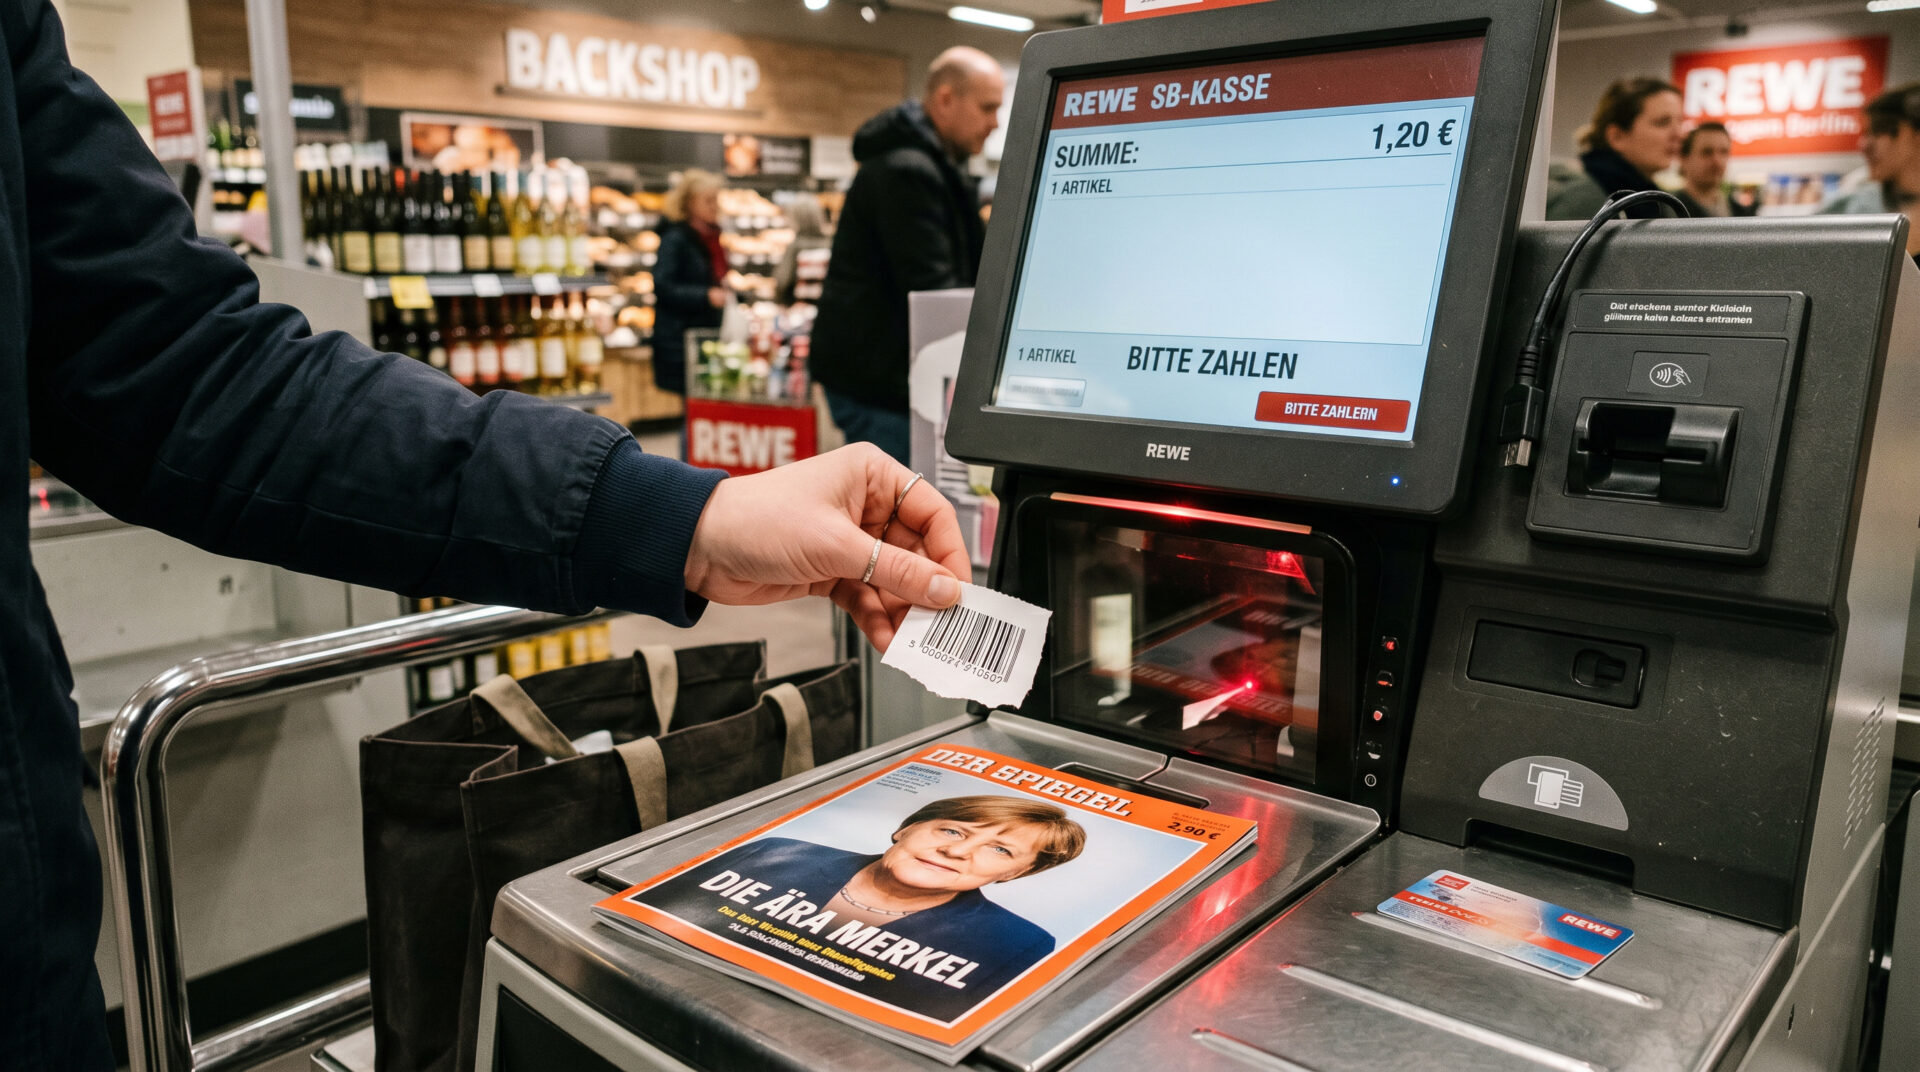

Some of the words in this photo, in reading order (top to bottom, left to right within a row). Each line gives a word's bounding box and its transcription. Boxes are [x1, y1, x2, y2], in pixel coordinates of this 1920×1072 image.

[505, 28, 760, 108] BACKSHOP
[1683, 55, 1866, 117] REWE
[1063, 86, 1138, 117] REWE
[1151, 73, 1272, 110] SB-KASSE
[1054, 141, 1140, 168] SUMME:
[1373, 121, 1429, 154] 1,20
[1437, 119, 1456, 145] €
[1051, 181, 1058, 195] 1
[1061, 179, 1113, 195] ARTIKEL
[1018, 347, 1025, 361] 1
[1027, 347, 1077, 364] ARTIKEL
[1127, 346, 1193, 373] BITTE
[1198, 349, 1298, 380] ZAHLEN
[1284, 402, 1319, 417] BITTE
[1321, 405, 1378, 421] ZAHLERN
[693, 418, 796, 469] REWE
[1146, 443, 1191, 461] REWE
[921, 748, 993, 773] DER
[992, 764, 1135, 817] SPIEGEL
[1167, 821, 1206, 836] 2,90
[1208, 832, 1222, 840] €
[698, 869, 773, 905] DIE
[752, 888, 838, 935] ÄRA
[825, 919, 980, 990] MERKEL
[1563, 914, 1617, 937] REWE
